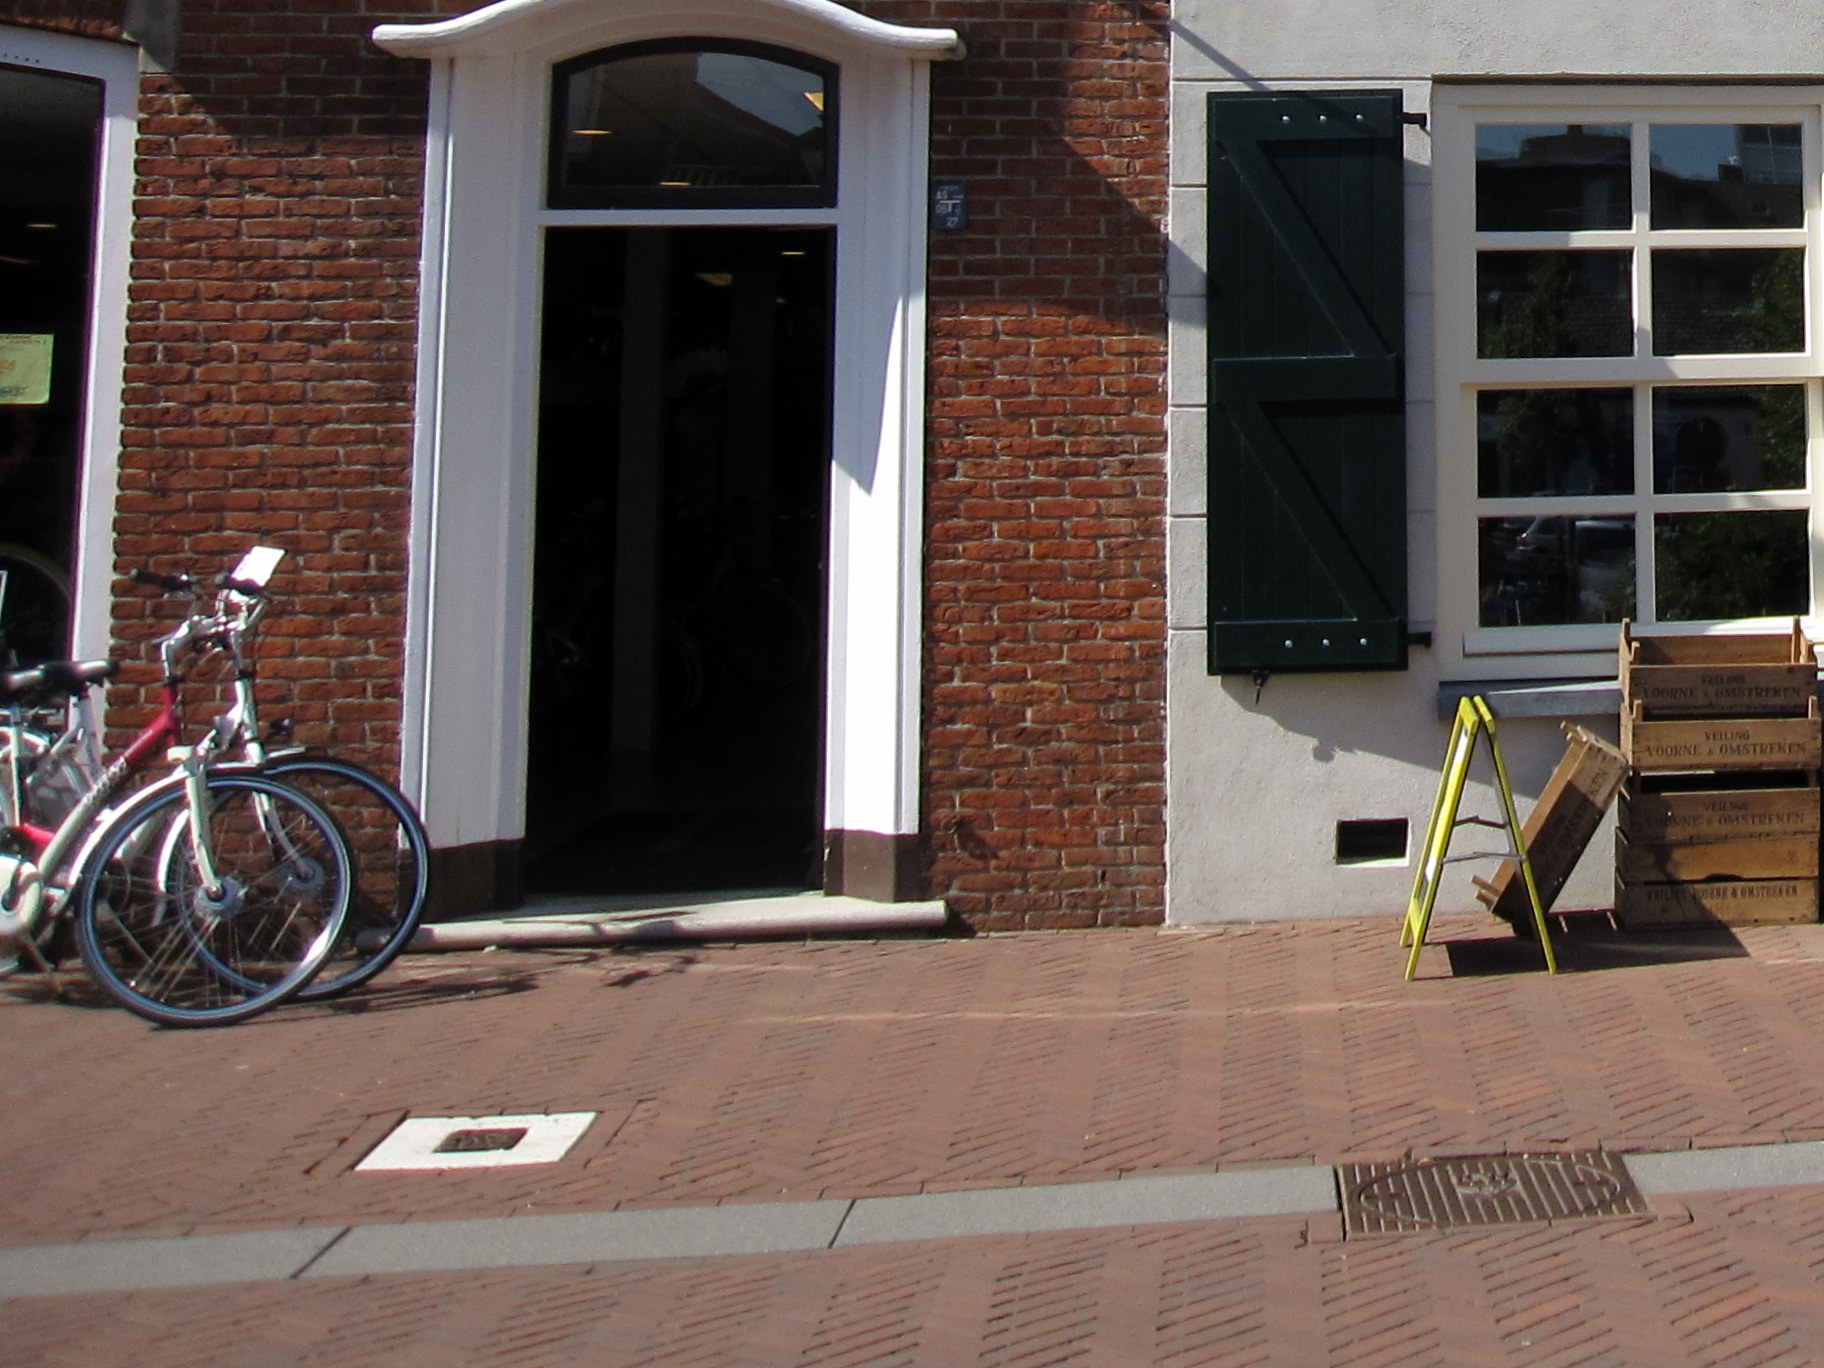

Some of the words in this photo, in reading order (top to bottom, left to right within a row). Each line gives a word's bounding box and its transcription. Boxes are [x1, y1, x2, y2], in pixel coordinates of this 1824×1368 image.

[1704, 731, 1750, 742] VEILING
[1648, 744, 1700, 757] VOORNE
[1719, 743, 1806, 755] OMSTREKEN
